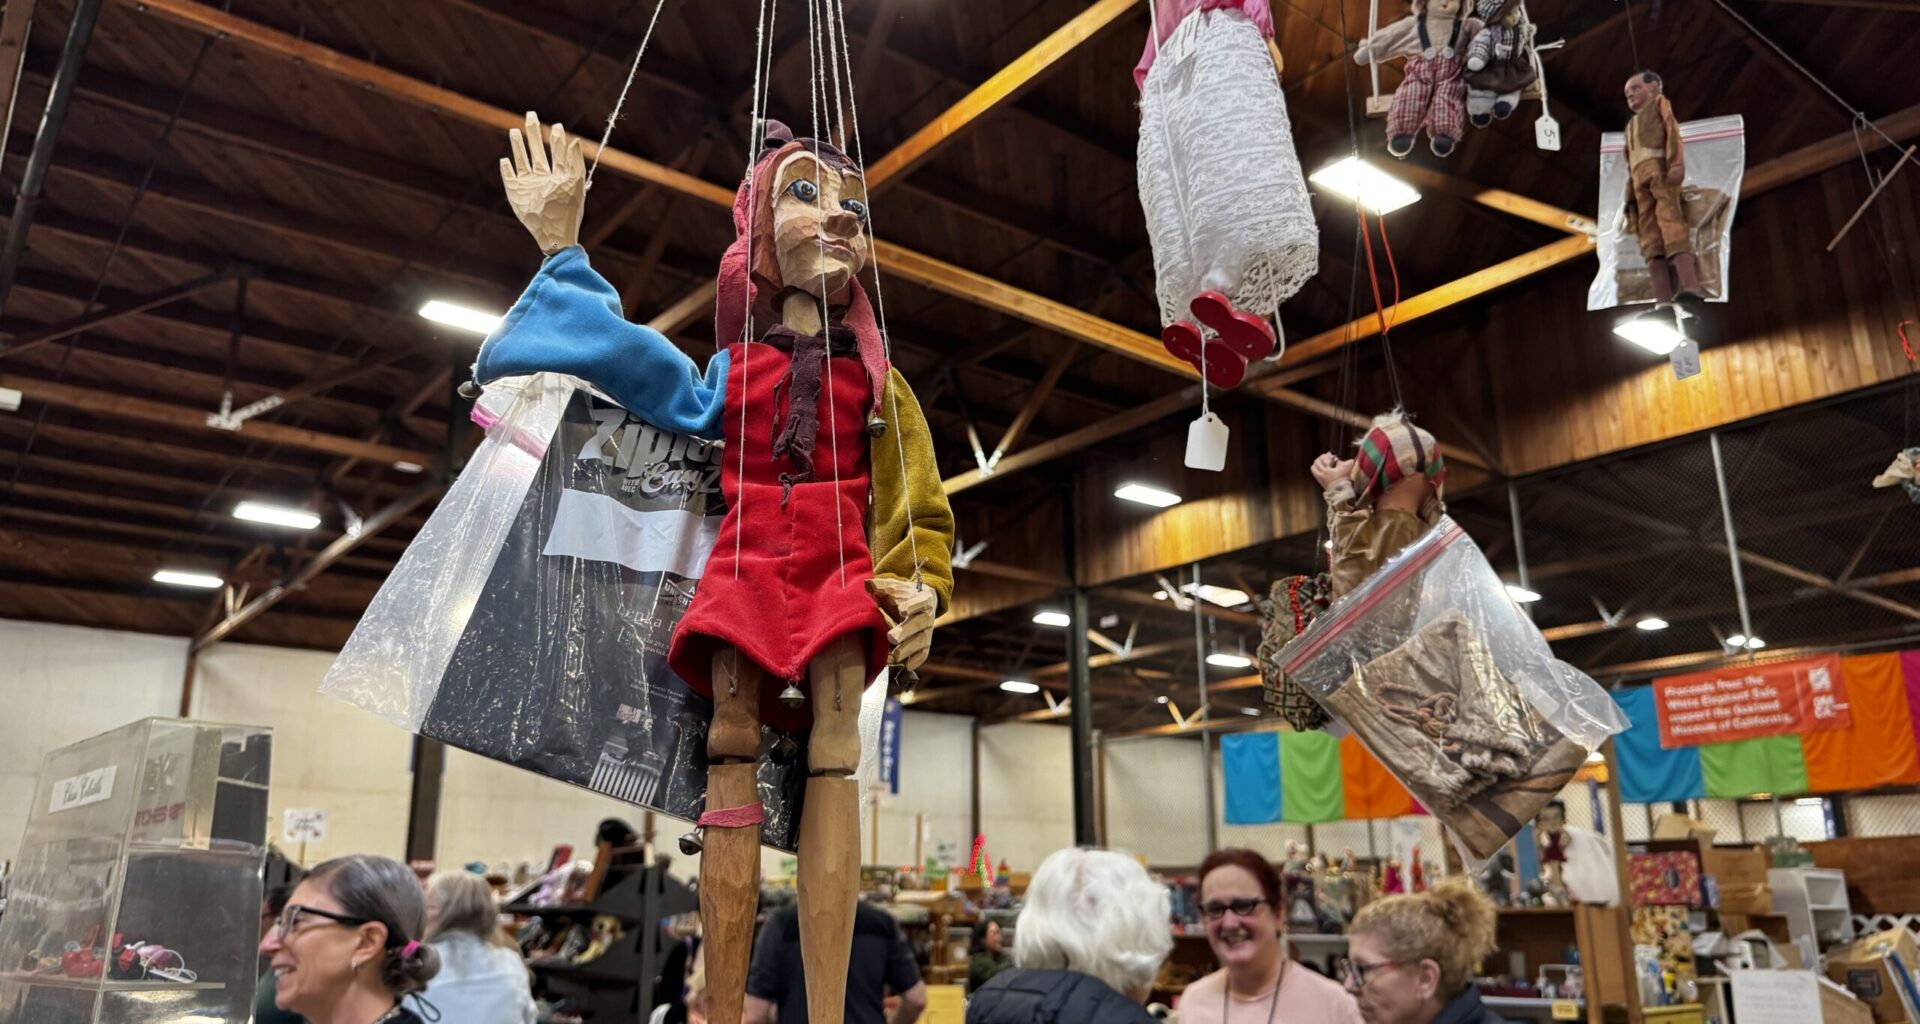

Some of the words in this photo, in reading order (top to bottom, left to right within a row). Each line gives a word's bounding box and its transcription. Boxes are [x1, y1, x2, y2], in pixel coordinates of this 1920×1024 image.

[577, 408, 723, 478] Ziplo
[1717, 678, 1743, 690] from
[1745, 675, 1764, 685] the
[1701, 691, 1749, 706] Elephant
[1751, 687, 1778, 698] Sale
[1713, 707, 1731, 717] the
